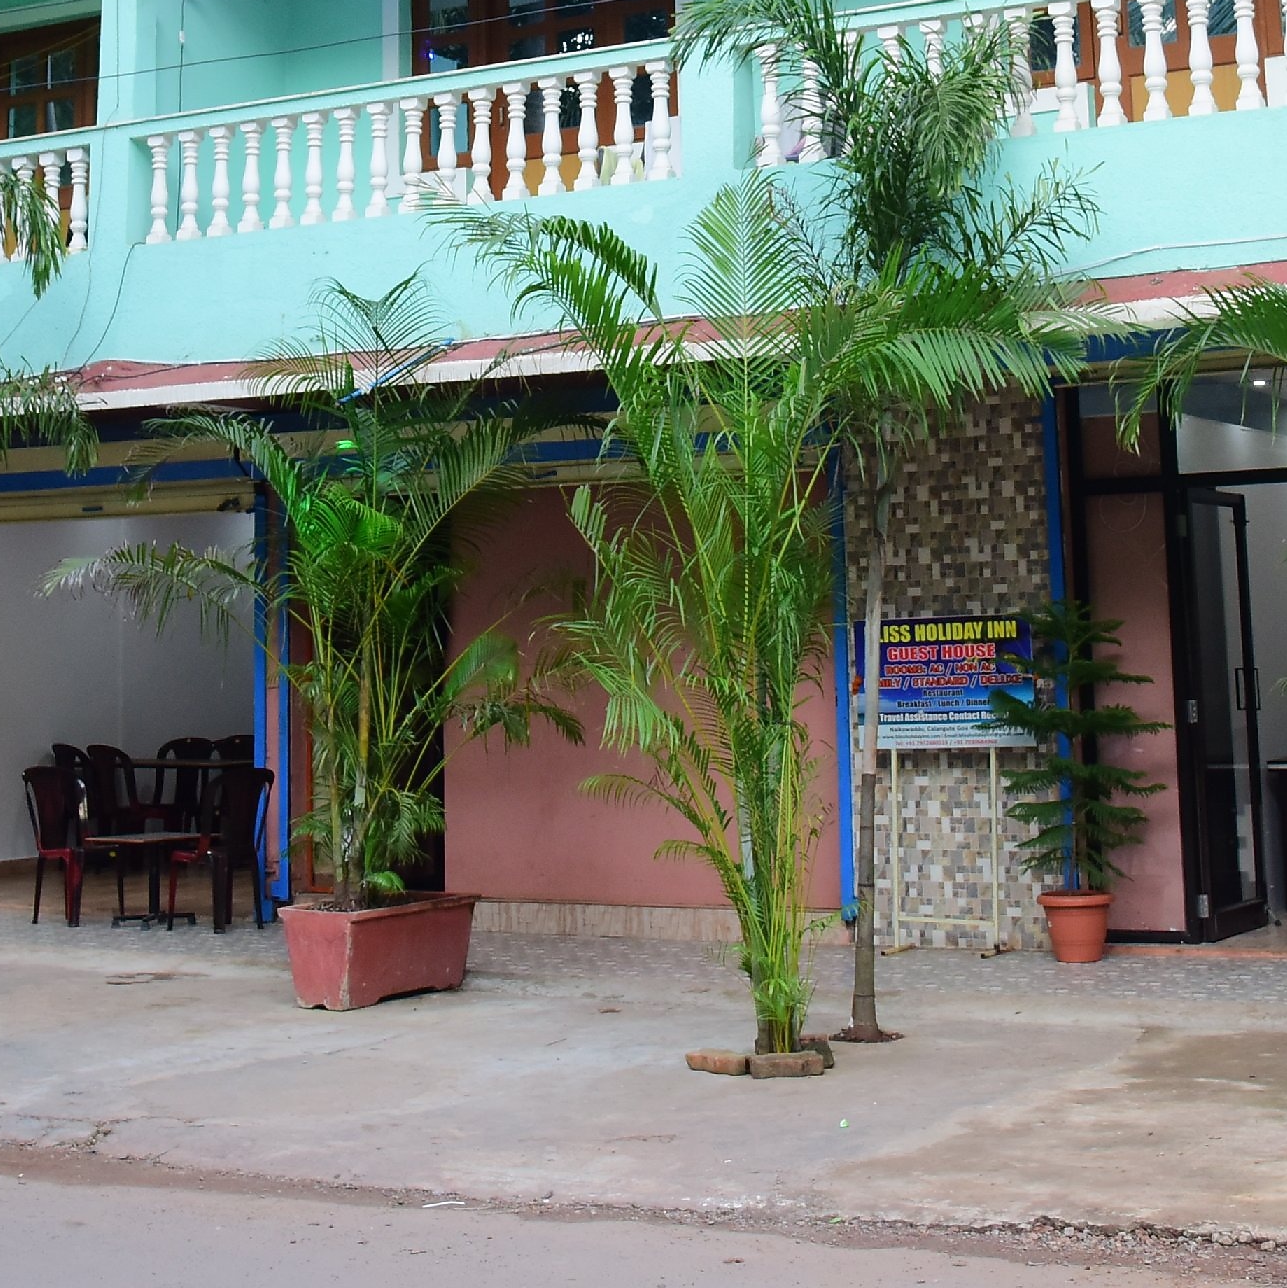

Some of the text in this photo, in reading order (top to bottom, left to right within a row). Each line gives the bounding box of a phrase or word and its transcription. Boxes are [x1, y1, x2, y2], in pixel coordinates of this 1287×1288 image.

[880, 620, 1017, 643] ISS HOLIDAY INN
[887, 643, 996, 662] GUEST HOUSE
[884, 663, 927, 676] ROOMS:
[928, 663, 944, 675] AC
[953, 661, 979, 673] NON
[980, 661, 996, 672] AC
[911, 675, 969, 688] STANDARD
[979, 674, 1024, 686] DELUXE
[923, 689, 963, 697] Restaurant
[896, 699, 932, 708] Breakfast
[937, 699, 959, 707] Lunch
[879, 713, 904, 722] Travel
[905, 712, 948, 722] Assistance
[949, 711, 980, 721] Contact
